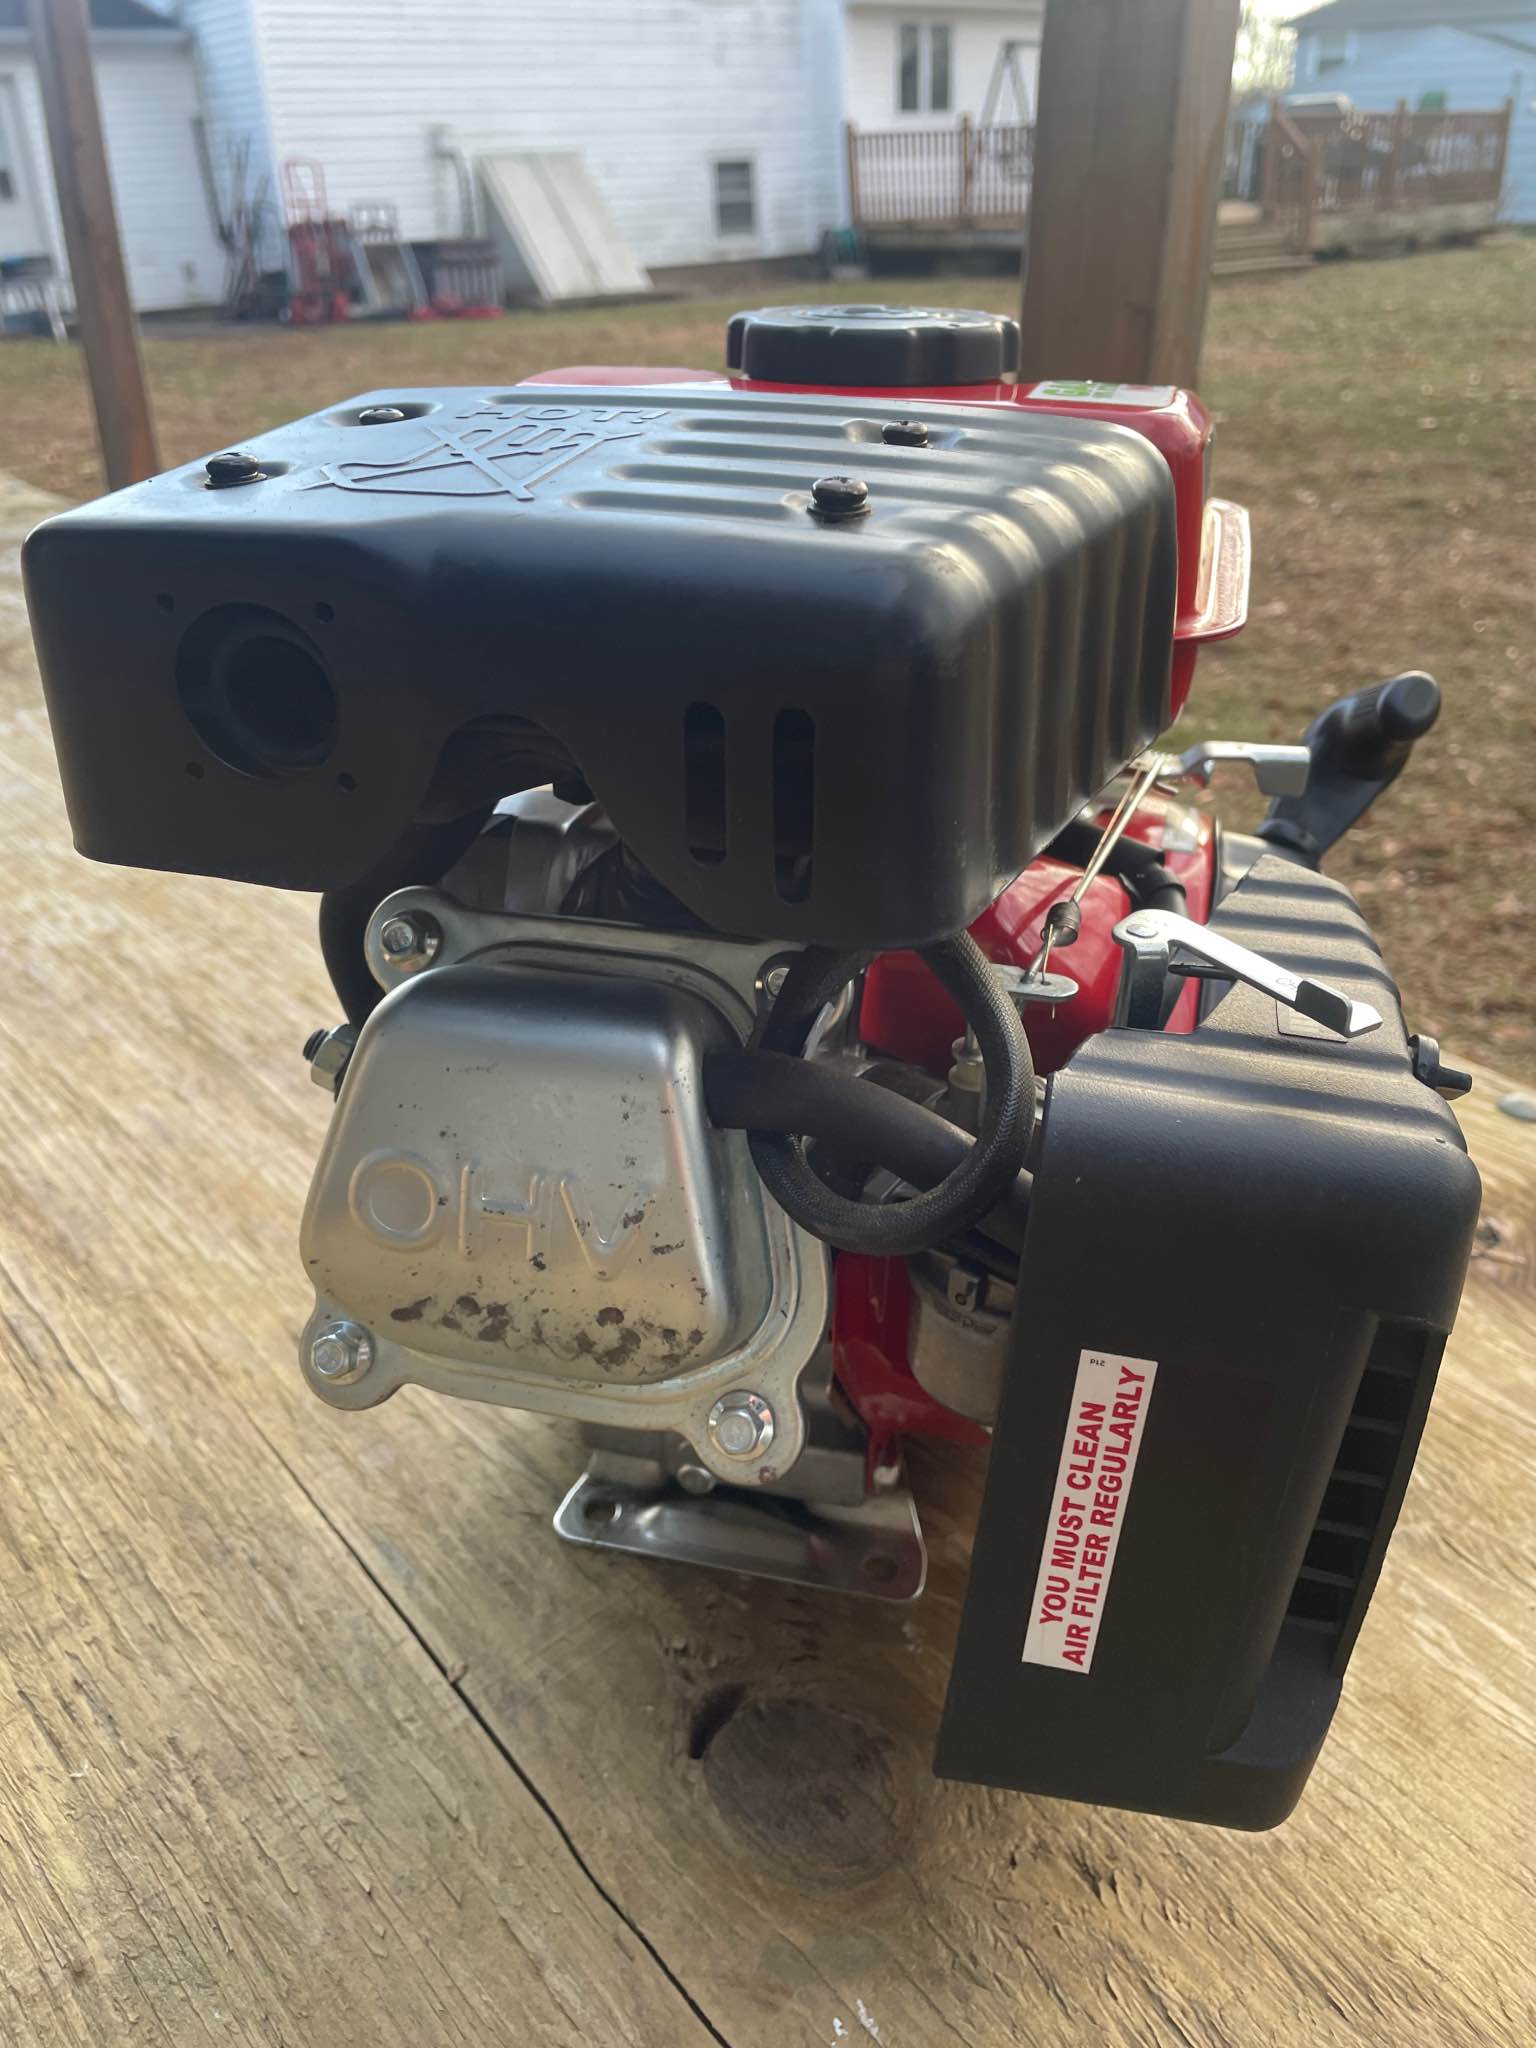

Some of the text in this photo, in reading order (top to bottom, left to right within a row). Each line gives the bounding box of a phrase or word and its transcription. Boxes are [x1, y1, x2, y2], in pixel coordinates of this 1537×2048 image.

[455, 406, 671, 424] HOT!
[348, 1148, 654, 1281] OHV
[1039, 1401, 1107, 1624] YOU MUST CLEAN
[1061, 1366, 1146, 1666] AIR FILTER REGULARLY
